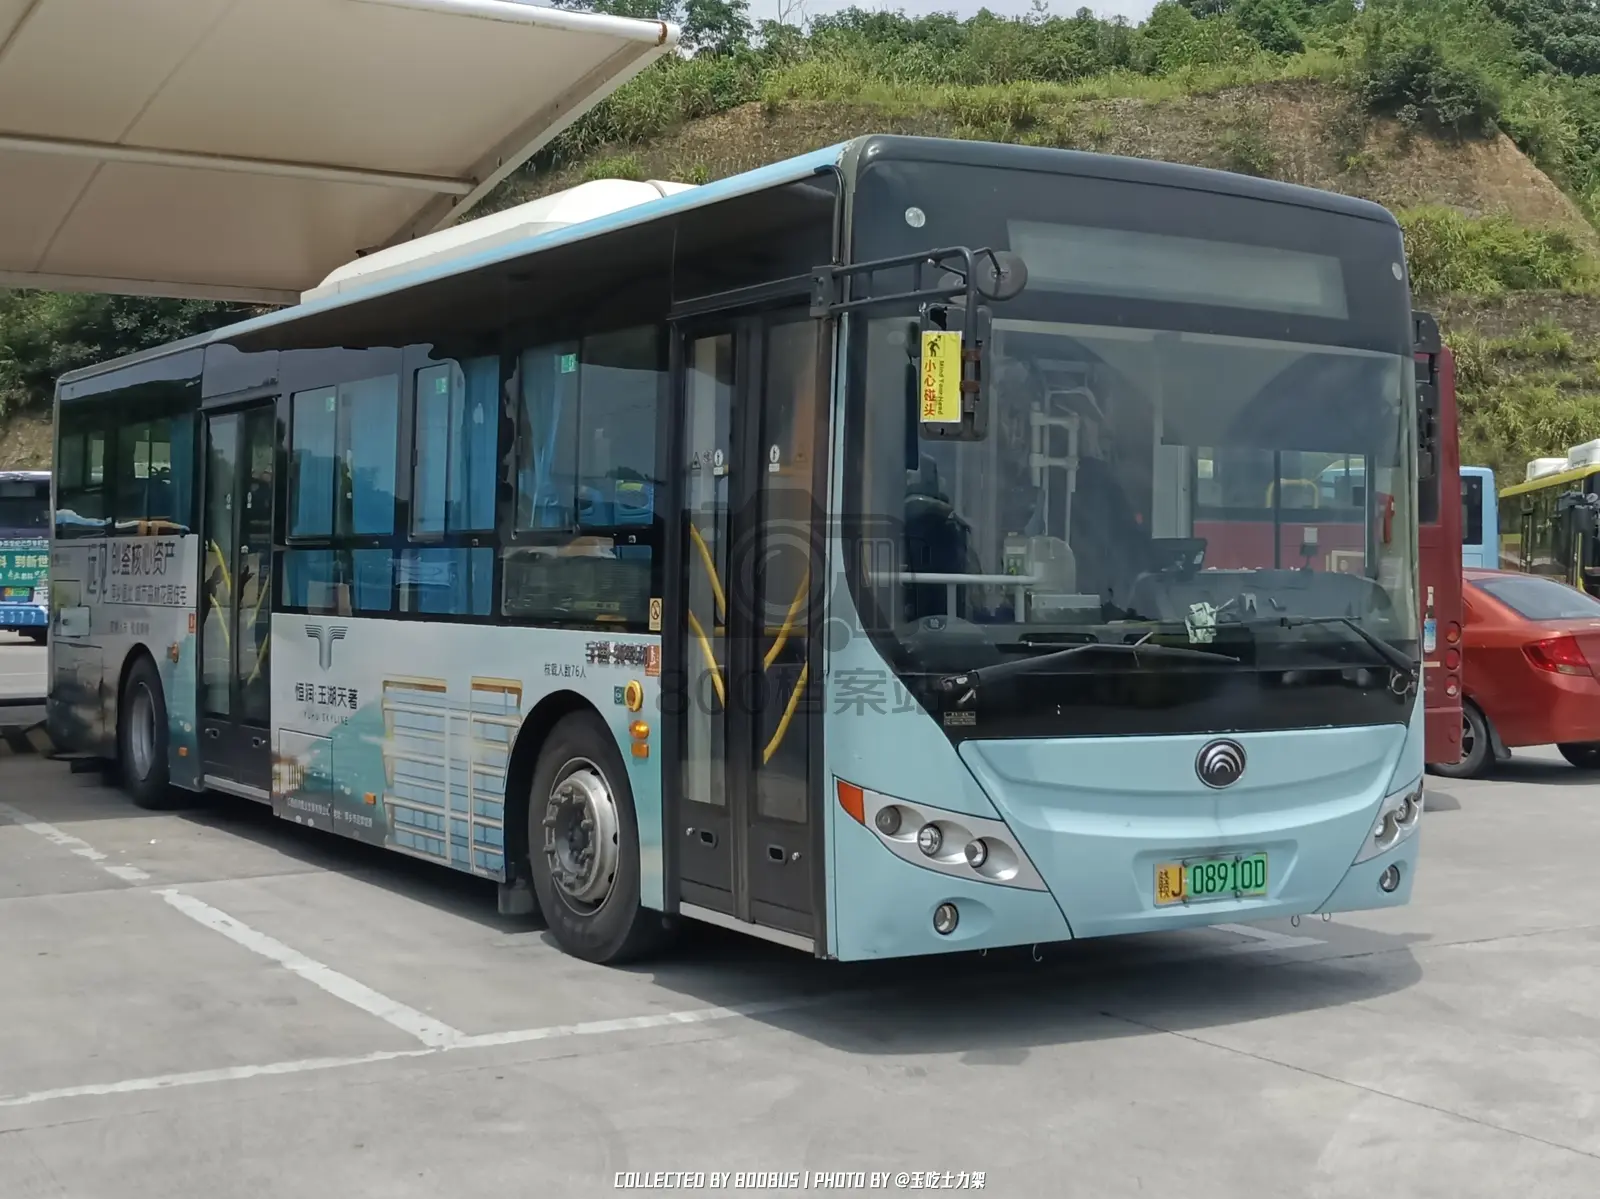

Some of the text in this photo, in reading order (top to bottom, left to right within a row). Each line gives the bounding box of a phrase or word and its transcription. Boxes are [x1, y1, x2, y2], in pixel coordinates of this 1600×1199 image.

[923, 359, 937, 417] 小心碰头
[543, 663, 587, 679] 核载人数76人
